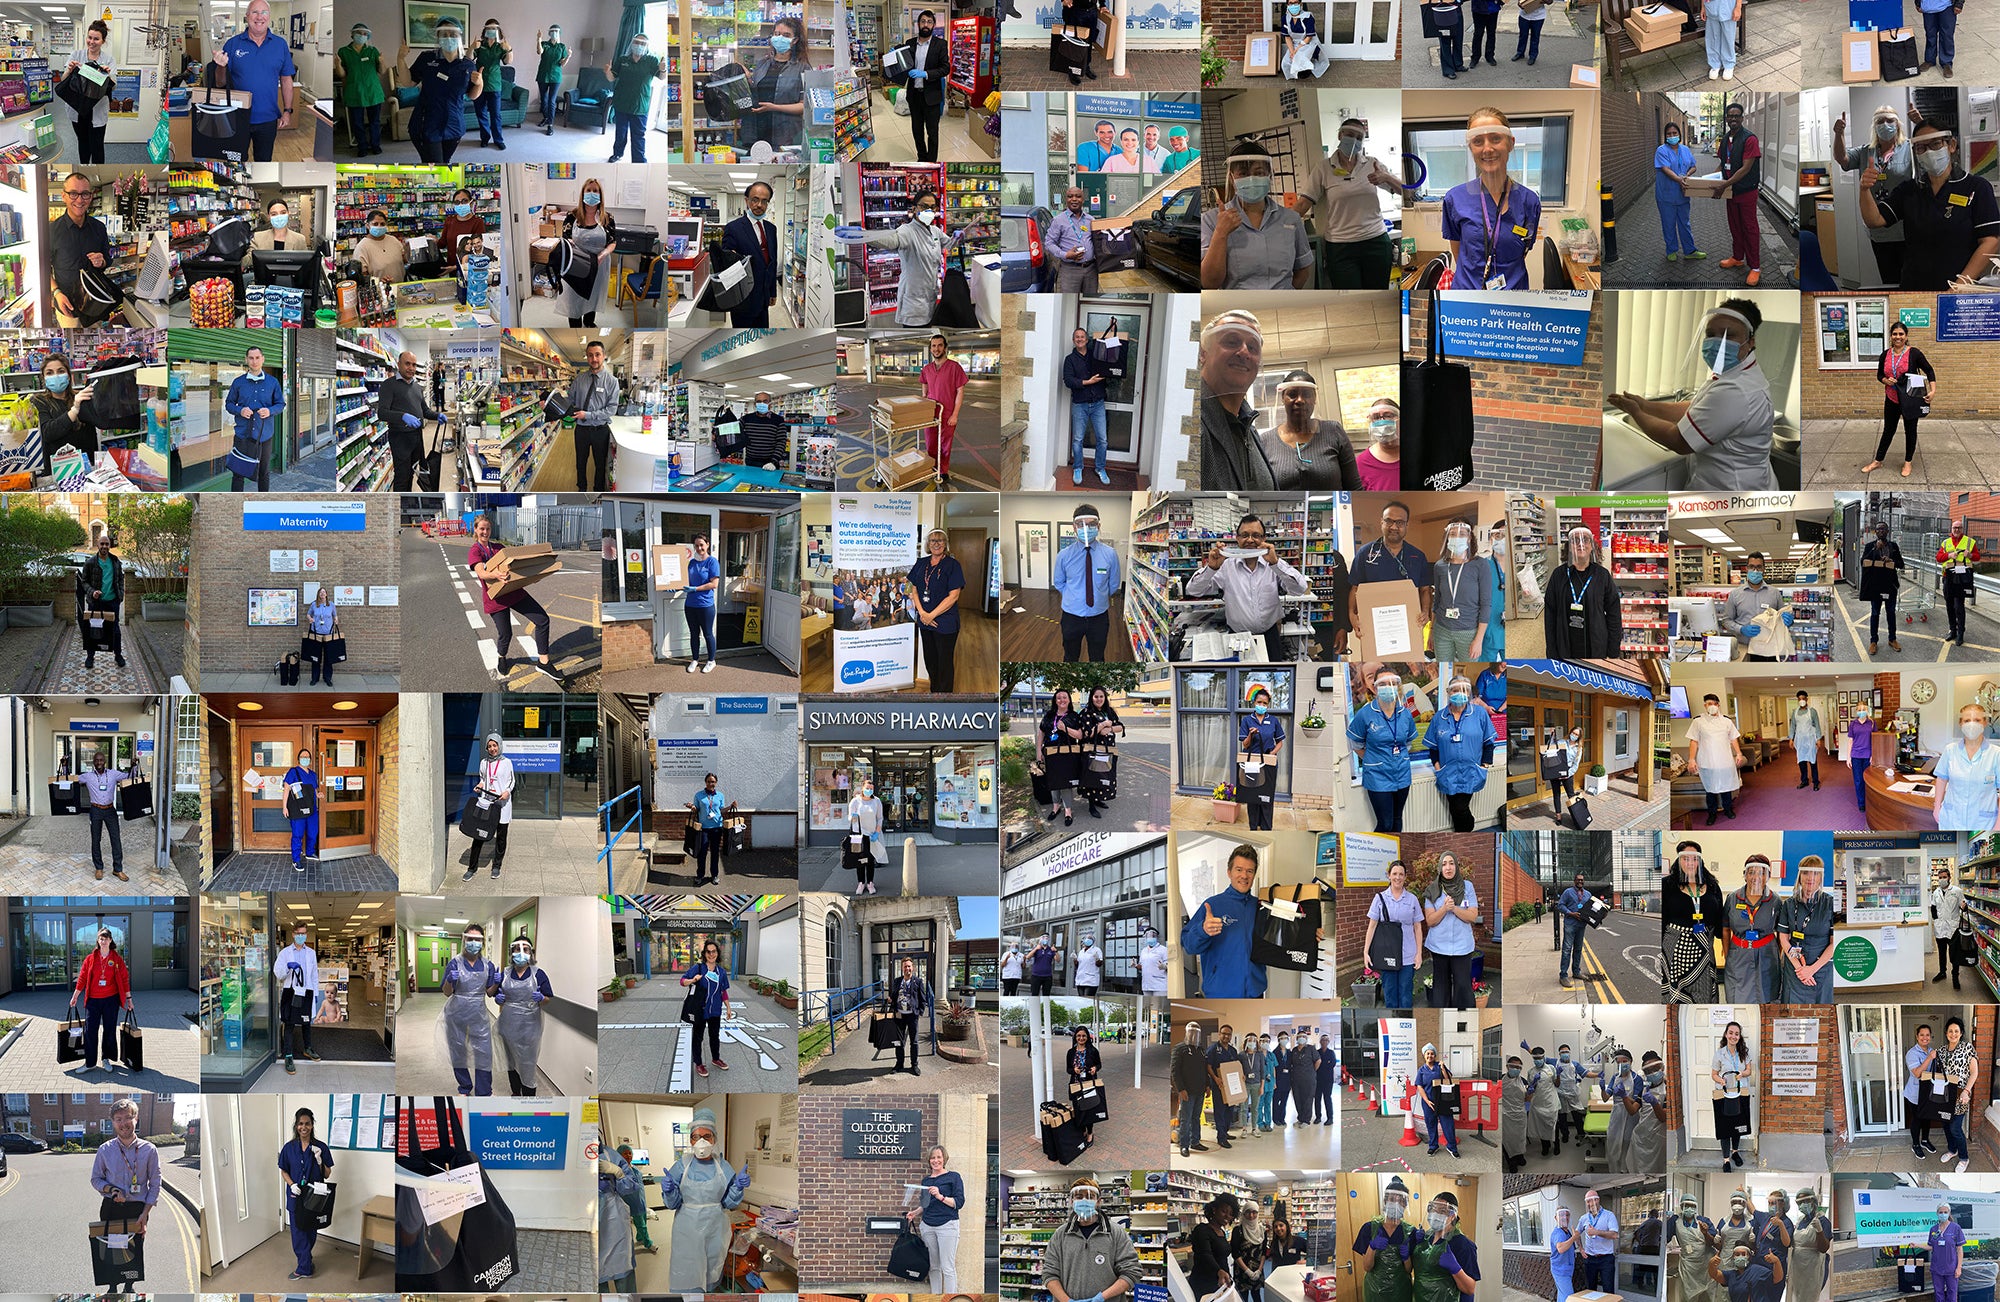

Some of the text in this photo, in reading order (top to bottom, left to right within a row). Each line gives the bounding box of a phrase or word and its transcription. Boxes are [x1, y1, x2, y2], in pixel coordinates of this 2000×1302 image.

[1091, 98, 1119, 107] Welcome
[1109, 107, 1132, 115] Surgery
[1570, 290, 1588, 298] NHS
[1490, 309, 1521, 318] Welcome
[1440, 314, 1581, 335] Queens Park Health Centre
[1444, 330, 1457, 339] you
[1458, 331, 1481, 340] require
[1482, 332, 1515, 341] assistance
[1516, 334, 1538, 344] please
[1551, 337, 1562, 345] for
[1563, 338, 1579, 347] help
[452, 346, 494, 354] prescripions
[1450, 337, 1467, 345] from
[1467, 338, 1478, 346] the
[1479, 339, 1494, 347] staff
[1504, 341, 1515, 349] the
[1516, 343, 1548, 353] Reception
[1474, 350, 1499, 358] Enquiries:
[1424, 465, 1463, 486] CAMERON
[1434, 473, 1463, 488] DESIGN
[1435, 481, 1463, 491] HOUSE
[1341, 490, 1349, 502] 5
[1625, 498, 1648, 506] Strength
[1678, 494, 1797, 513] Kamsons Pharmacy
[280, 517, 328, 529] Maternity
[859, 522, 892, 531] delivering
[839, 530, 911, 539] outstanding palliative
[883, 539, 892, 548] by
[1550, 659, 1639, 693] FONTHILL HOUSE
[733, 702, 764, 711] Sanctuary
[810, 712, 997, 730] SIMMONS PHARMACY
[1844, 840, 1894, 849] PRESCRIPTIONS
[1048, 845, 1102, 876] HOMECARE
[871, 1112, 894, 1122] THE
[497, 1125, 531, 1133] Welcome
[851, 1122, 913, 1133] OLD COURT
[482, 1139, 556, 1149] Great Ormond
[863, 1134, 899, 1144] HOUSE
[858, 1145, 905, 1155] SURGERY
[482, 1152, 556, 1163] Street Hospital
[1860, 1218, 1920, 1228] Golden Jubilee
[474, 1254, 512, 1284] CAMERON
[485, 1266, 512, 1285] DESIGN
[488, 1270, 513, 1290] HOUSE
